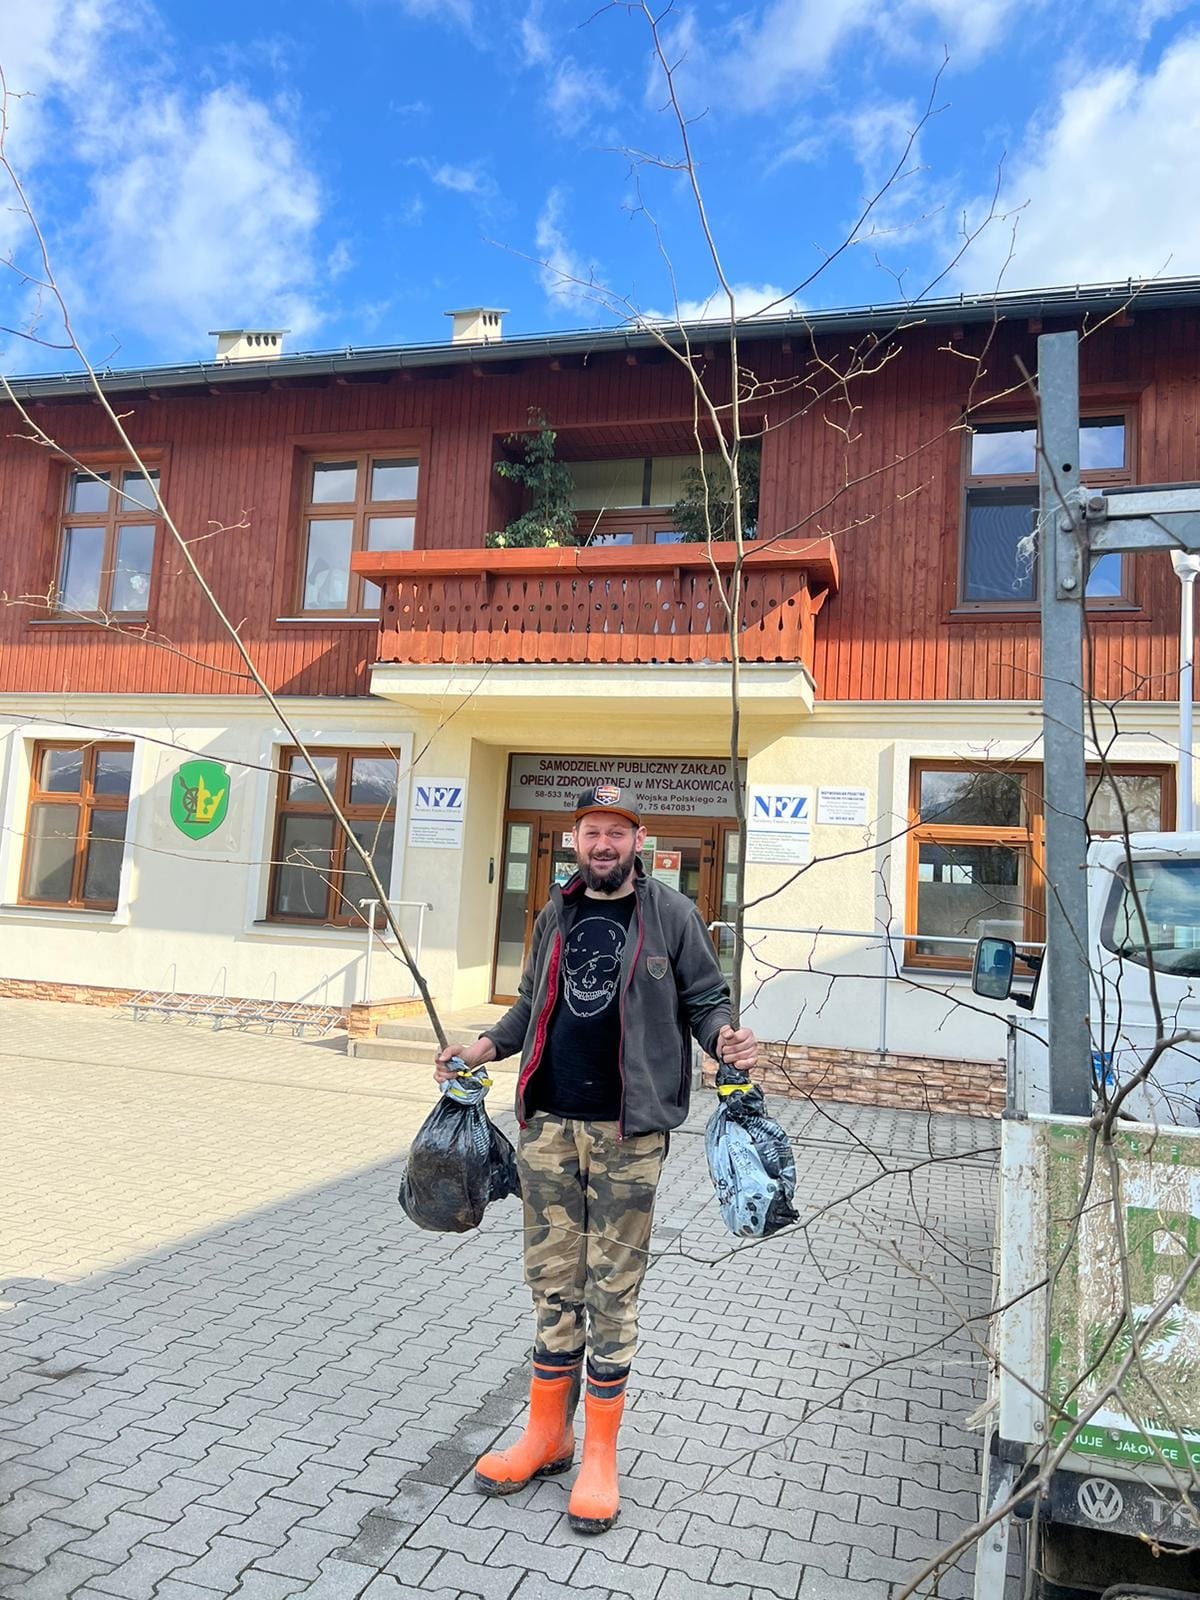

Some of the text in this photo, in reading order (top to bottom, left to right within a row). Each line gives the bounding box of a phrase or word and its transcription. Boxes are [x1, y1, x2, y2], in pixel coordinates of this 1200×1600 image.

[539, 759, 727, 775] SAMODZIELNY PUBLICZNY ZAKŁAD
[520, 774, 554, 786] OPIEKI
[556, 776, 631, 789] ZDROWOTNEJ
[634, 780, 643, 789] w
[415, 786, 462, 808] NFZ
[535, 790, 562, 798] 58-533
[636, 793, 728, 805] Wojska Polskiego 2a
[660, 803, 696, 812] 6470831
[752, 795, 809, 819] NFZ
